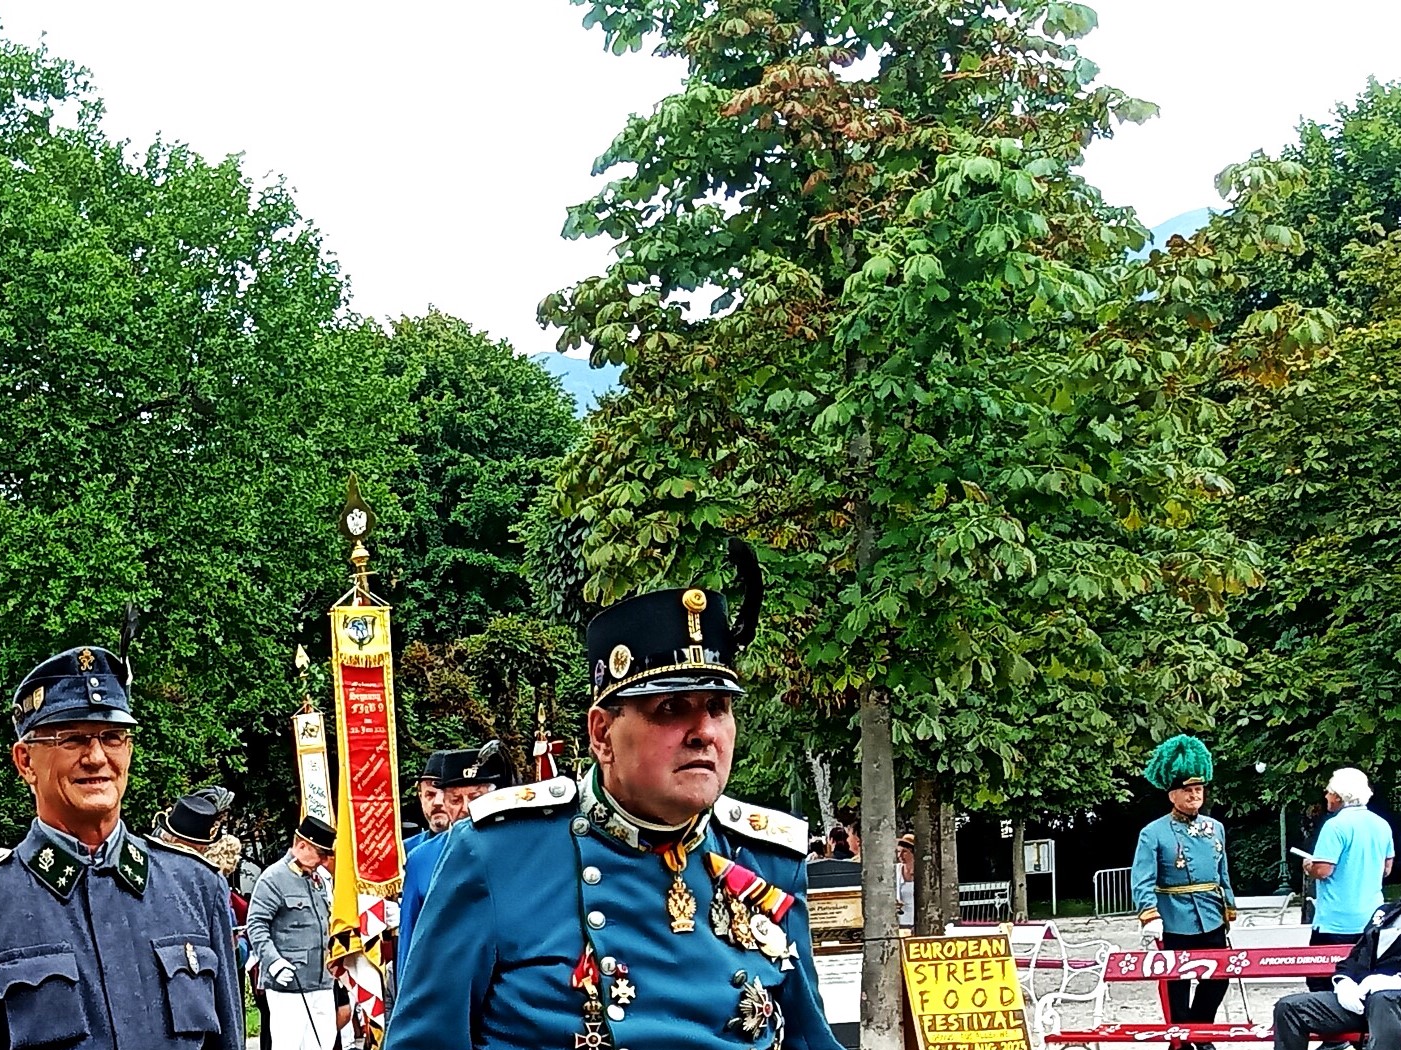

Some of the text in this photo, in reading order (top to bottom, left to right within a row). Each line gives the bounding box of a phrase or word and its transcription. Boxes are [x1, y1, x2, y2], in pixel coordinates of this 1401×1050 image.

[909, 938, 1006, 960] EUROPEAN
[914, 959, 1009, 984] STREET
[919, 986, 1015, 1012] FOOD
[922, 1010, 1024, 1032] FESTIVAL
